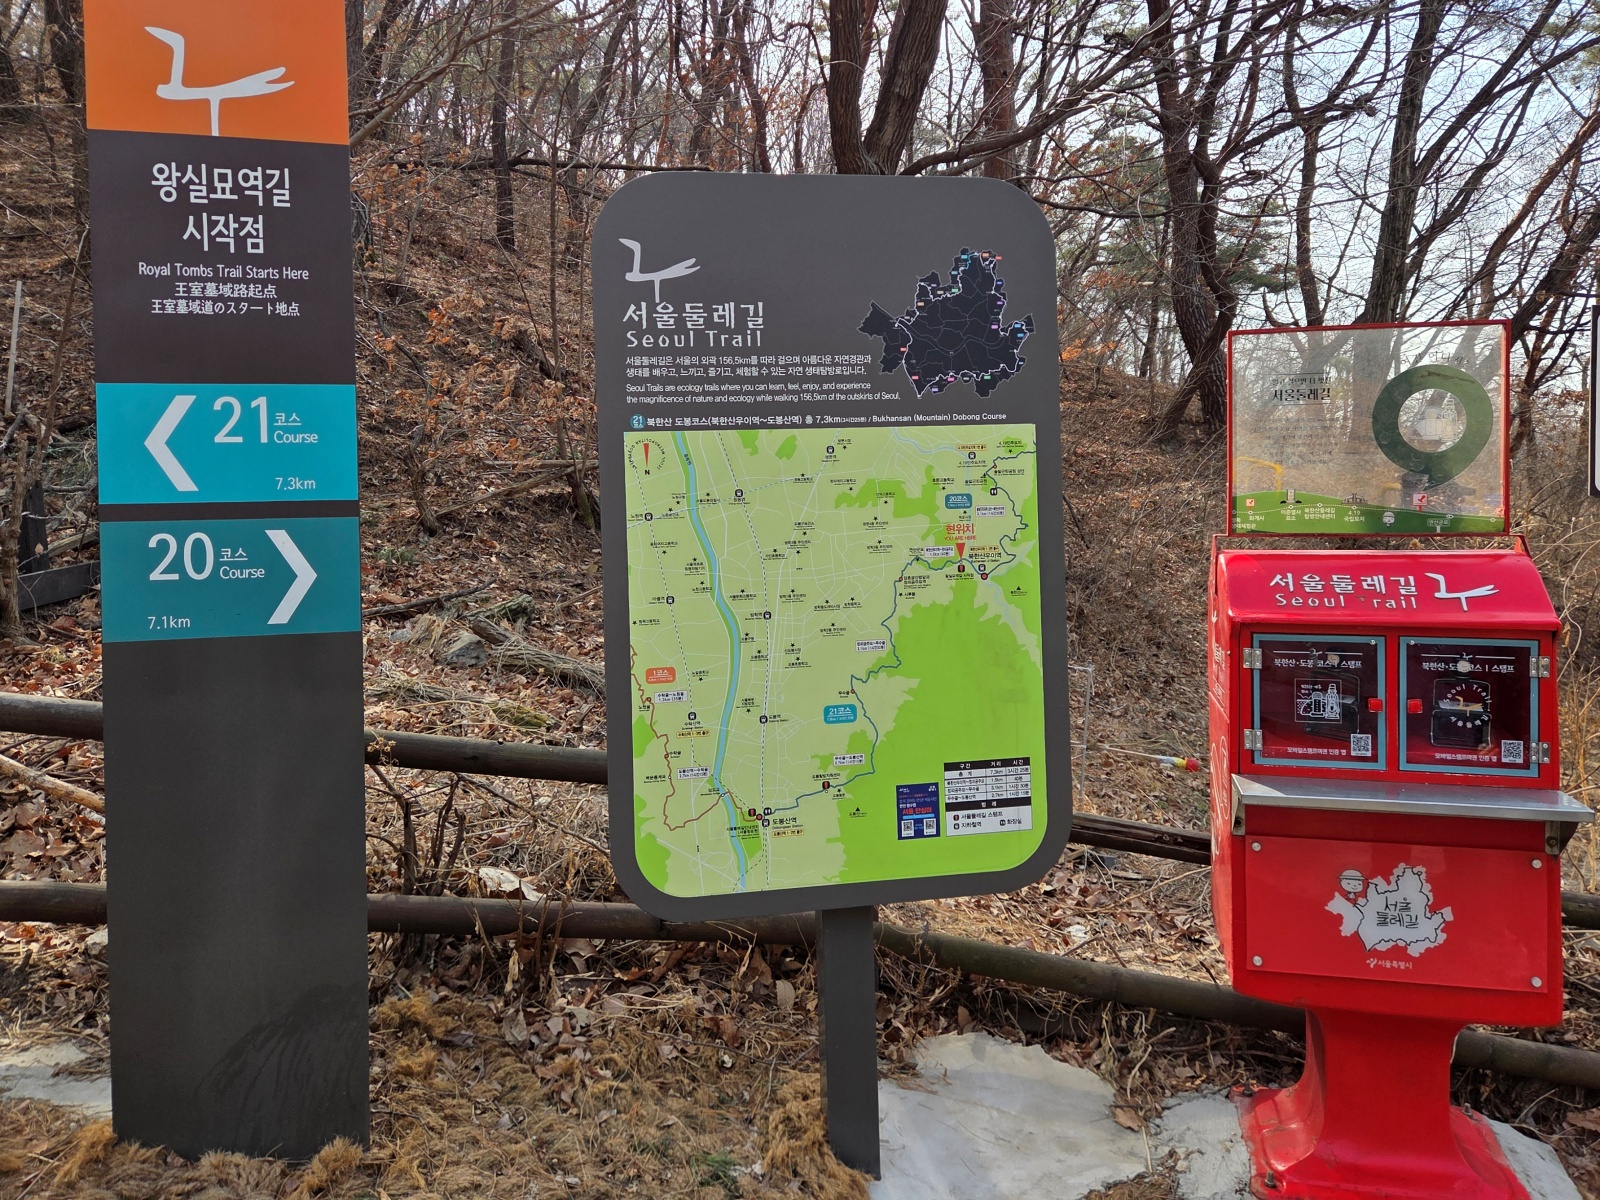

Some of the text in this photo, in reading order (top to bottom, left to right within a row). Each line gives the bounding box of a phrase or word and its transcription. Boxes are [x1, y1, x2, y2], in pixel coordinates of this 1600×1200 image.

[151, 161, 291, 208] 왕실묘역길
[182, 212, 264, 254] 시작점
[138, 262, 309, 280] Royal Tombs Trail Starts Here
[174, 282, 277, 298] 王室墓域路起点
[151, 299, 300, 317] 王室墓域道のスタート地点
[622, 301, 764, 330] 서울둘레길
[627, 330, 762, 348] Seoul Trail
[625, 356, 674, 366] 서울둘레길은
[675, 356, 699, 366] 서울의
[701, 356, 716, 365] 외곽
[760, 355, 775, 365] 따라
[777, 355, 800, 365] 걸으며
[802, 355, 832, 364] 아름다운
[834, 354, 871, 364] 자연경관과
[626, 367, 650, 377] 생태를
[735, 367, 759, 377] 체험할
[760, 367, 769, 376] 수
[771, 367, 786, 376] 있는
[788, 367, 803, 376] 자연
[626, 383, 646, 392] Seoul
[646, 383, 664, 392] Trails
[677, 383, 703, 393] ecology
[704, 383, 719, 391] trails
[720, 383, 741, 391] where
[742, 384, 754, 392] you
[823, 382, 835, 390] and
[836, 382, 871, 391] experience
[1272, 387, 1331, 402] 서울둘레길
[626, 395, 637, 403] the
[639, 395, 683, 404] magnificence
[684, 395, 691, 403] of
[692, 395, 713, 403] nature
[715, 394, 728, 403] and
[729, 394, 755, 404] ecology
[756, 394, 773, 402] while
[774, 393, 798, 402] walking
[829, 392, 836, 401] of
[836, 392, 846, 401] the
[847, 392, 873, 400] outskirts
[874, 392, 881, 400] of
[881, 391, 900, 400] Seoul.
[213, 396, 302, 444] 21 코스
[633, 415, 643, 424] 21
[646, 417, 672, 427] 북한산
[872, 414, 912, 423] Bukhansan
[913, 413, 951, 422] (Mountain)
[952, 413, 980, 422] Dobong
[273, 431, 318, 444] Course
[275, 477, 316, 490] 7.3km
[945, 523, 975, 534] 현위치
[148, 532, 248, 581] 20 코스
[219, 566, 265, 580] Course
[1269, 572, 1418, 596] 서울둘레길
[1275, 593, 1417, 609] Seoul rail
[147, 616, 191, 630] 7.1km
[1421, 662, 1460, 671] 북한산·도
[772, 817, 797, 825] 도봉산역
[1384, 896, 1412, 913] 서울
[1376, 911, 1419, 929] 둘레길
[1377, 960, 1413, 970] 서울특별시
